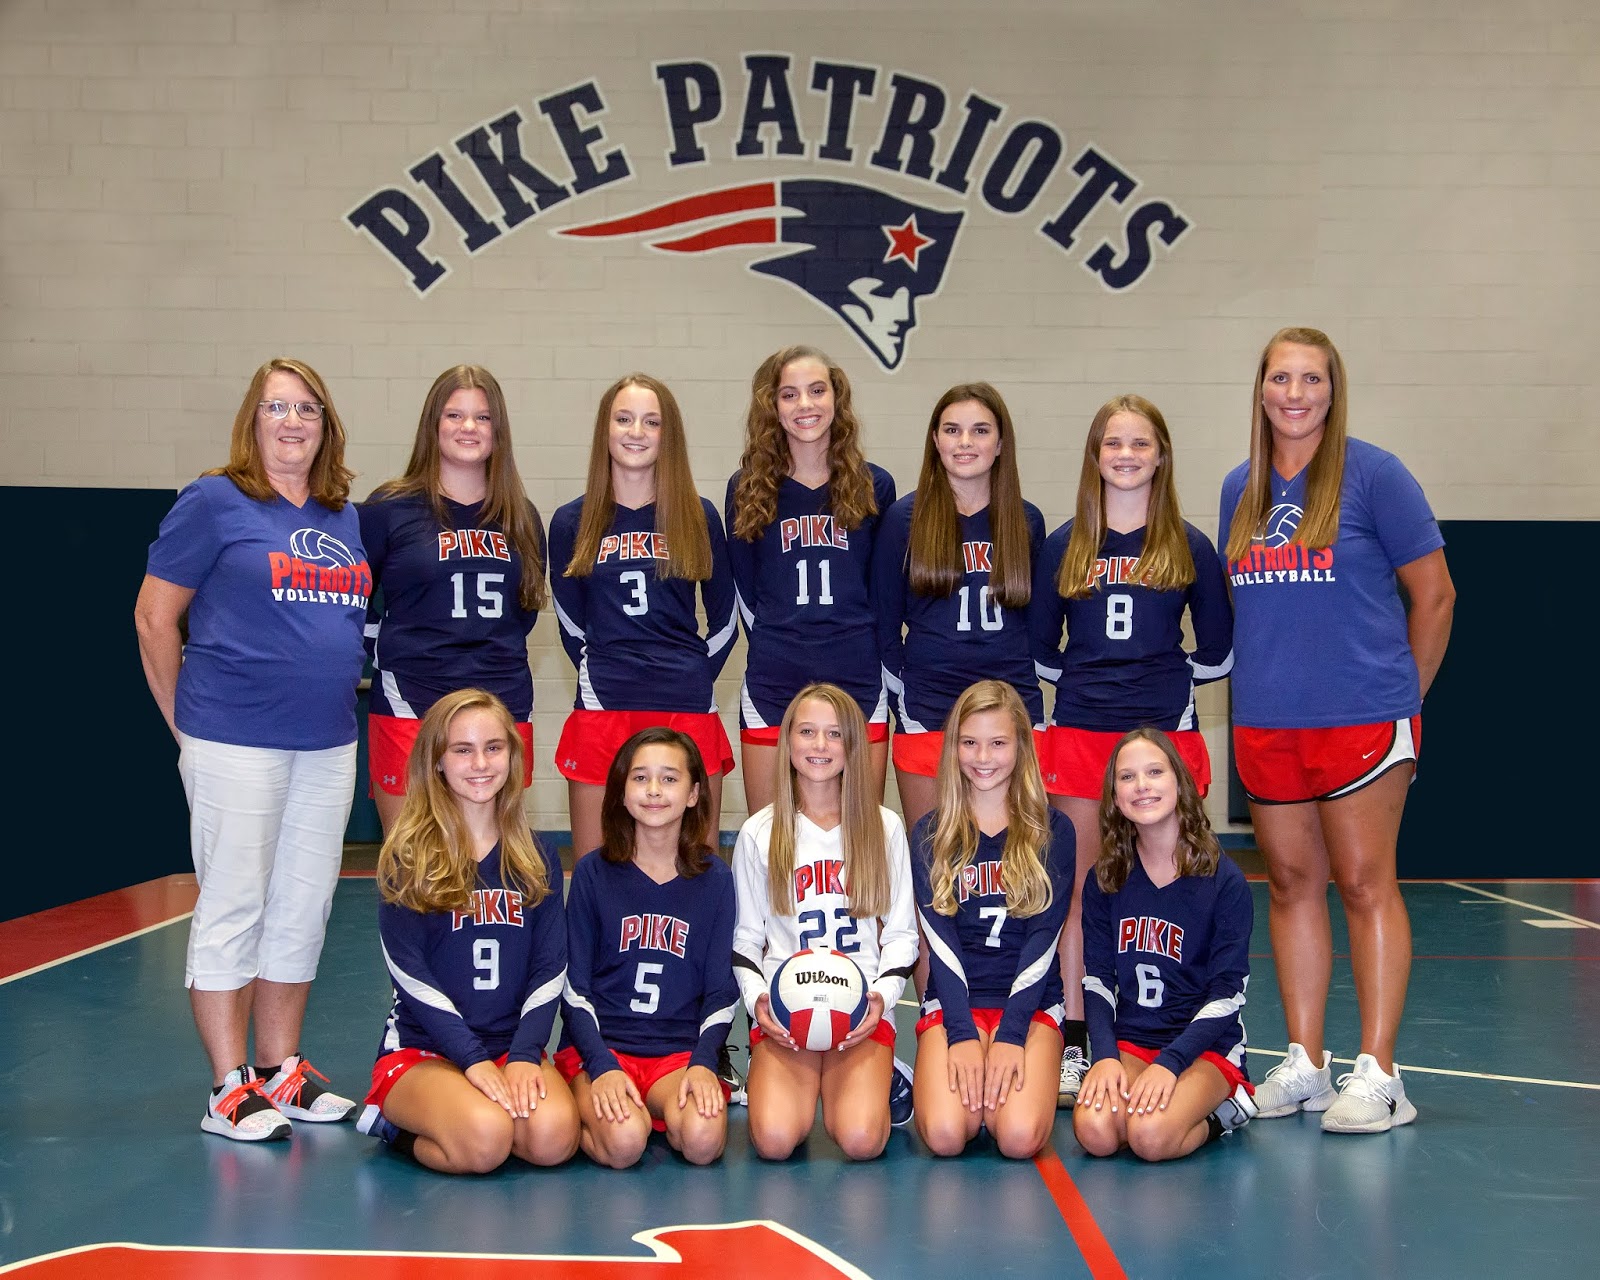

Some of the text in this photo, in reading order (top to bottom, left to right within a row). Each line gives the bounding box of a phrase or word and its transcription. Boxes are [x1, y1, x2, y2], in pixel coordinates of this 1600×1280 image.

[344, 53, 1191, 295] PIKE PATRIOTS
[437, 529, 511, 562] PIKE
[597, 531, 670, 564] PIKE
[779, 514, 849, 553] PIKE
[268, 551, 373, 597] PATRIOTS
[962, 541, 994, 574] IK
[1230, 569, 1336, 587] VOLLEYBALL
[271, 588, 369, 610] VOLLEYBALL
[450, 572, 505, 619] 15
[619, 570, 649, 616] 3
[795, 559, 834, 606] 11
[956, 585, 1004, 631] 10
[1105, 593, 1134, 640] 8
[793, 859, 851, 903] PIK
[958, 860, 1008, 904] PIK
[618, 913, 690, 959] PIKE
[798, 907, 861, 954] 22
[979, 907, 1007, 948] 7
[1117, 916, 1185, 964] PIKE
[472, 938, 501, 990] 9
[795, 970, 850, 988] Wilson
[1135, 963, 1165, 1008] 6
[629, 962, 664, 1015] 5
